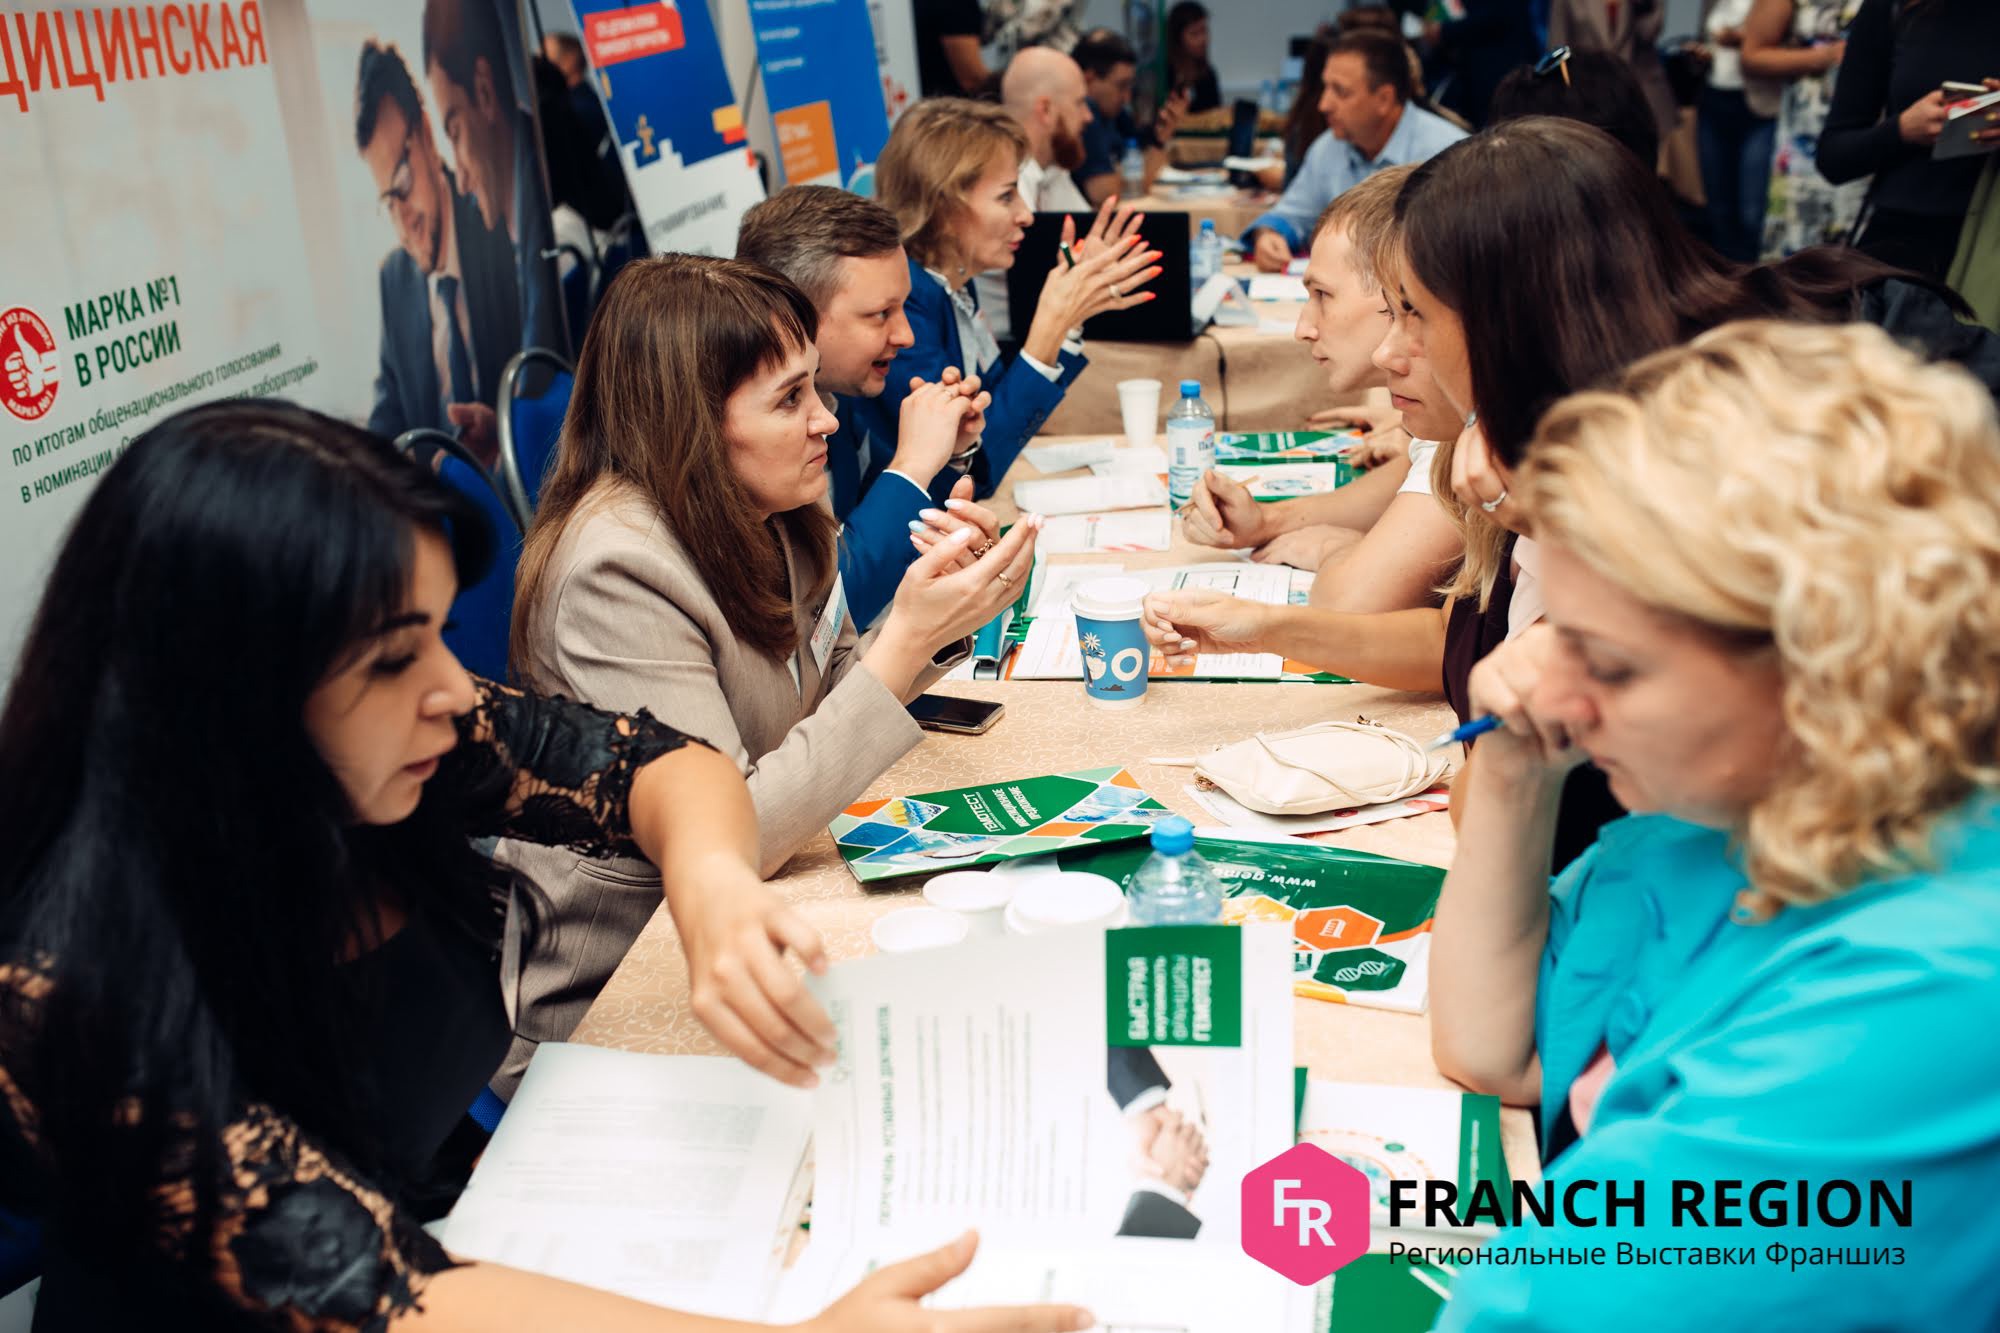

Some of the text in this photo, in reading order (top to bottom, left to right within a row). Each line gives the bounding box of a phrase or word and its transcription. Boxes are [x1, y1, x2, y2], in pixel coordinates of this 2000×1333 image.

[64, 286, 145, 341] МАРКА
[146, 275, 181, 314] №1
[74, 320, 182, 387] В РОССИИ
[12, 444, 32, 467] по
[34, 421, 86, 457] итогам
[88, 369, 215, 435] общенационального
[215, 342, 282, 384] голосования
[21, 448, 114, 504] в номинации
[962, 793, 1002, 833] ГЕМОТЕСТ
